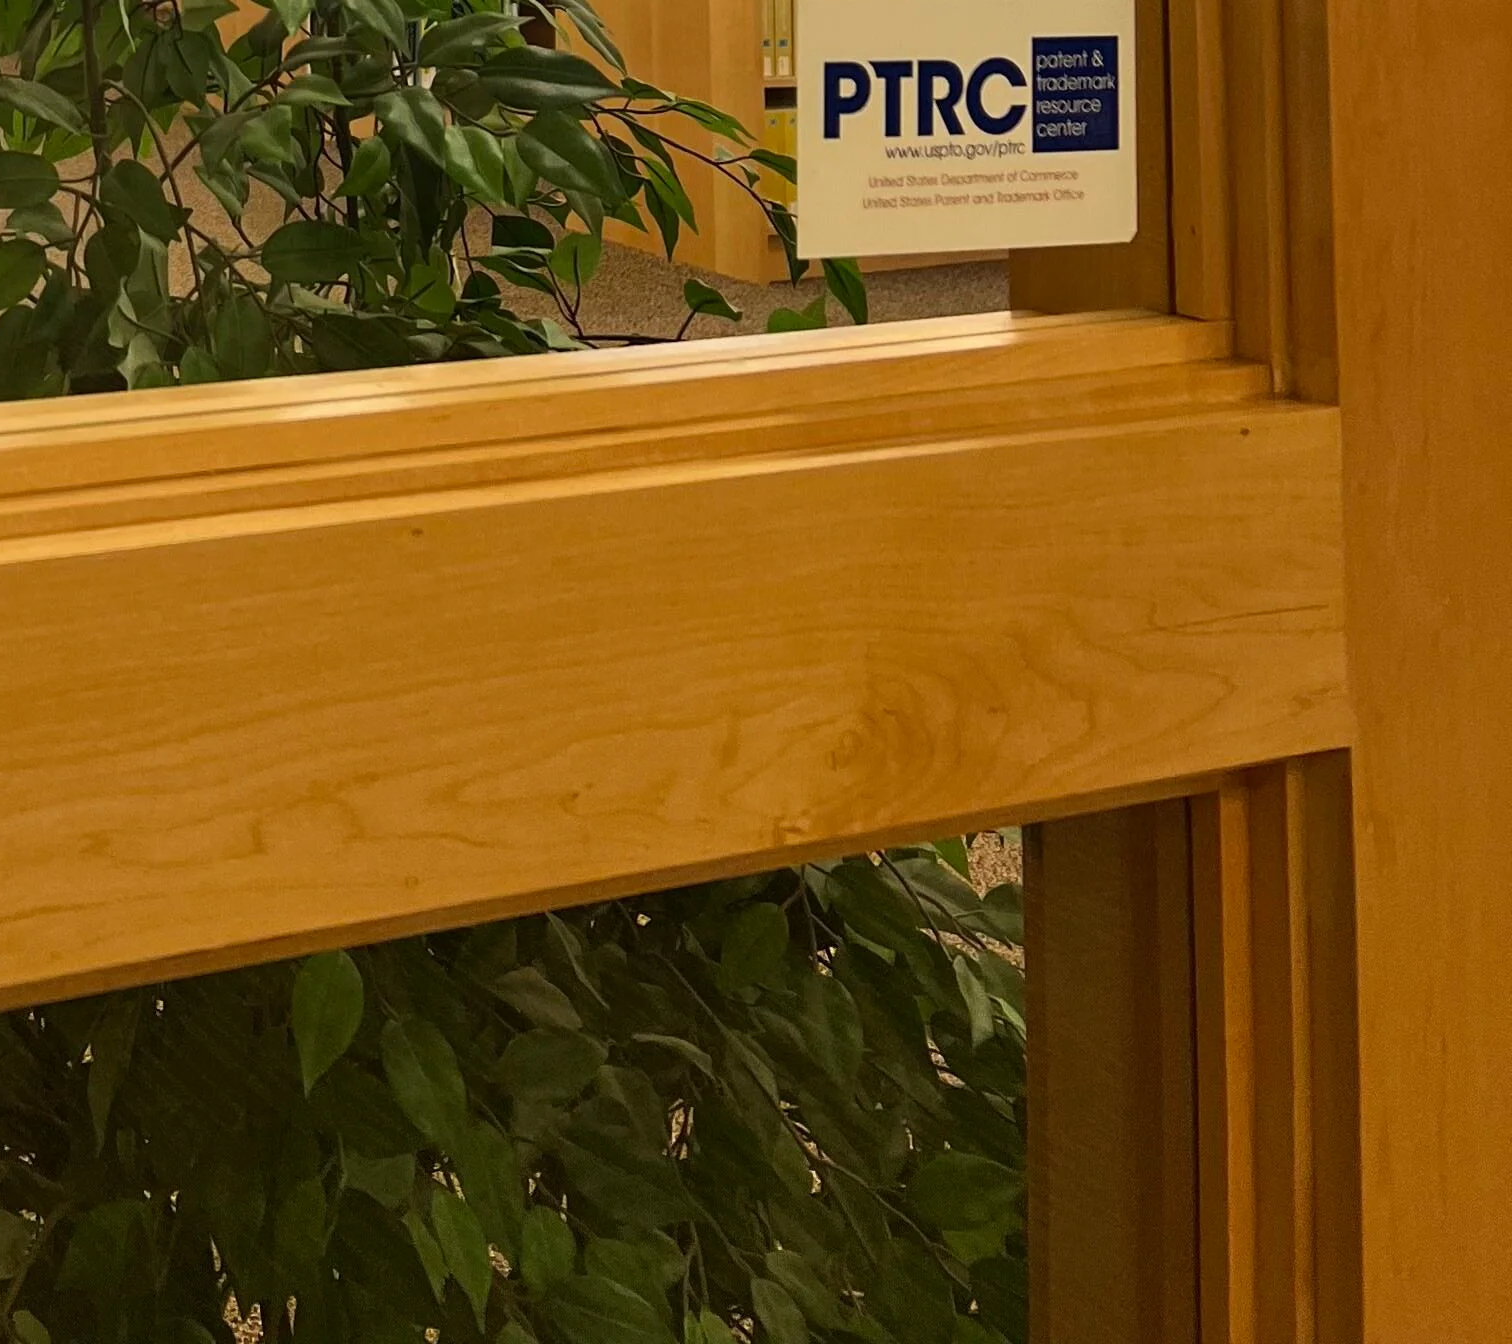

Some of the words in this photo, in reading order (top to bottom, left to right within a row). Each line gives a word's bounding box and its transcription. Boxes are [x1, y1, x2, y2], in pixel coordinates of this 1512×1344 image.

[1036, 52, 1088, 71] patent
[1091, 49, 1105, 67] &
[1037, 73, 1116, 92] trademark
[823, 57, 1027, 139] PTRC
[1037, 97, 1102, 114] resource
[1037, 120, 1088, 138] center
